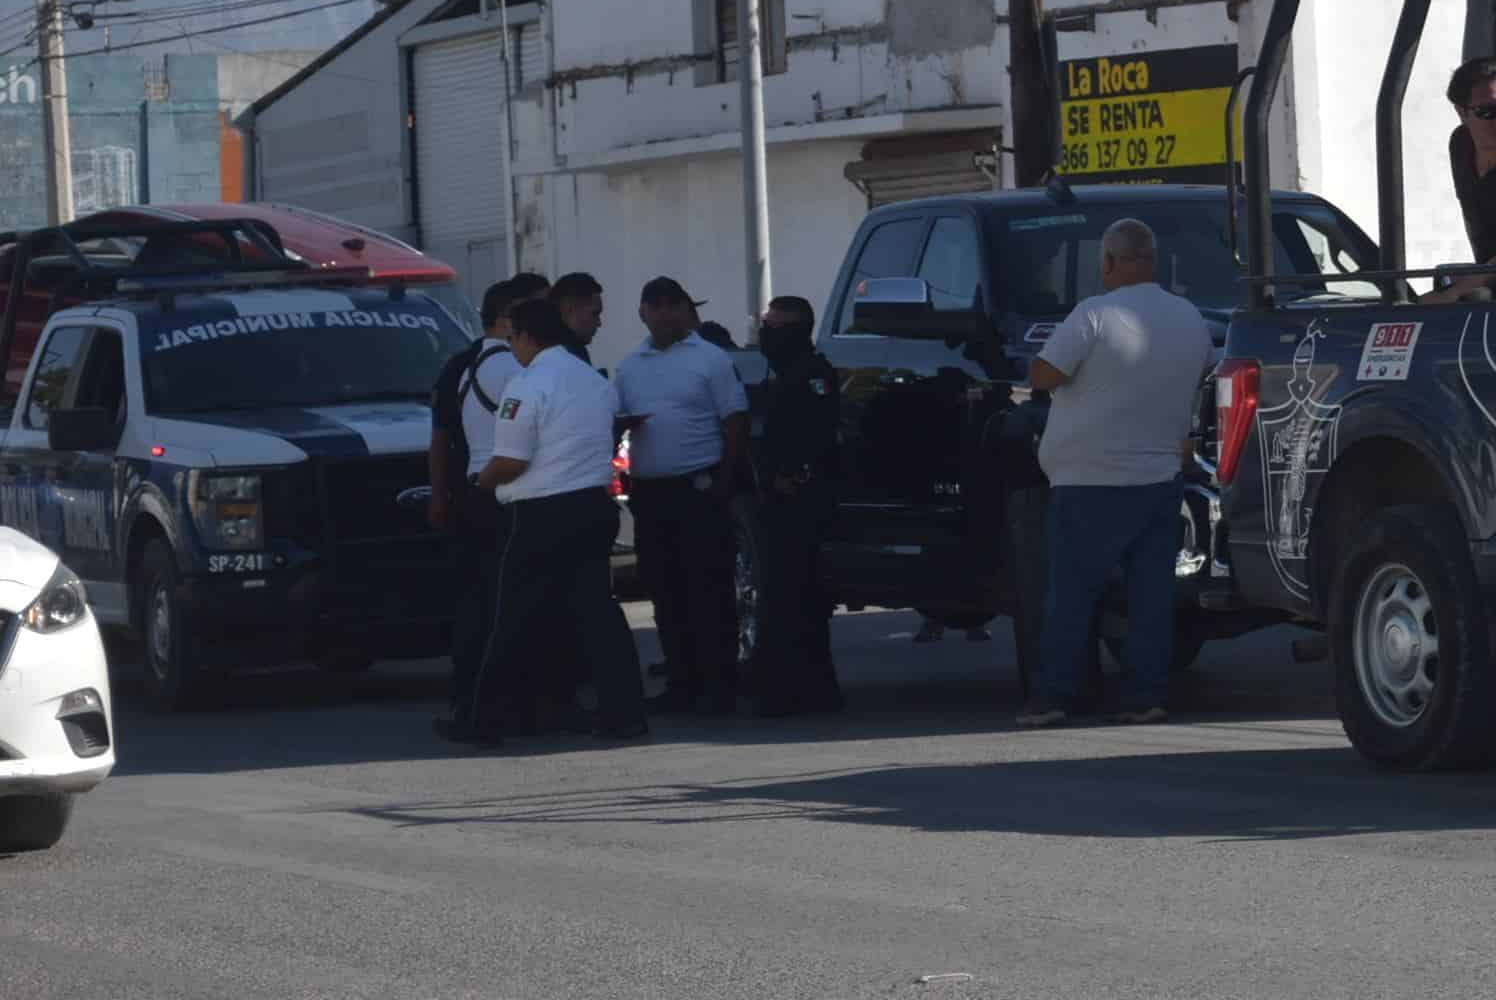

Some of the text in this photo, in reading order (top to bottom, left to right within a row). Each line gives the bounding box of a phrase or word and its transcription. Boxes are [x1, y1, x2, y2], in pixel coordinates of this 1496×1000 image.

[1068, 57, 1150, 97] La Roca
[1067, 99, 1165, 137] SE RENTA
[1096, 139, 1121, 169] 137
[1127, 138, 1148, 166] 09
[1155, 134, 1177, 165] 27
[1376, 327, 1413, 345] 911
[208, 553, 263, 573] SP-241
